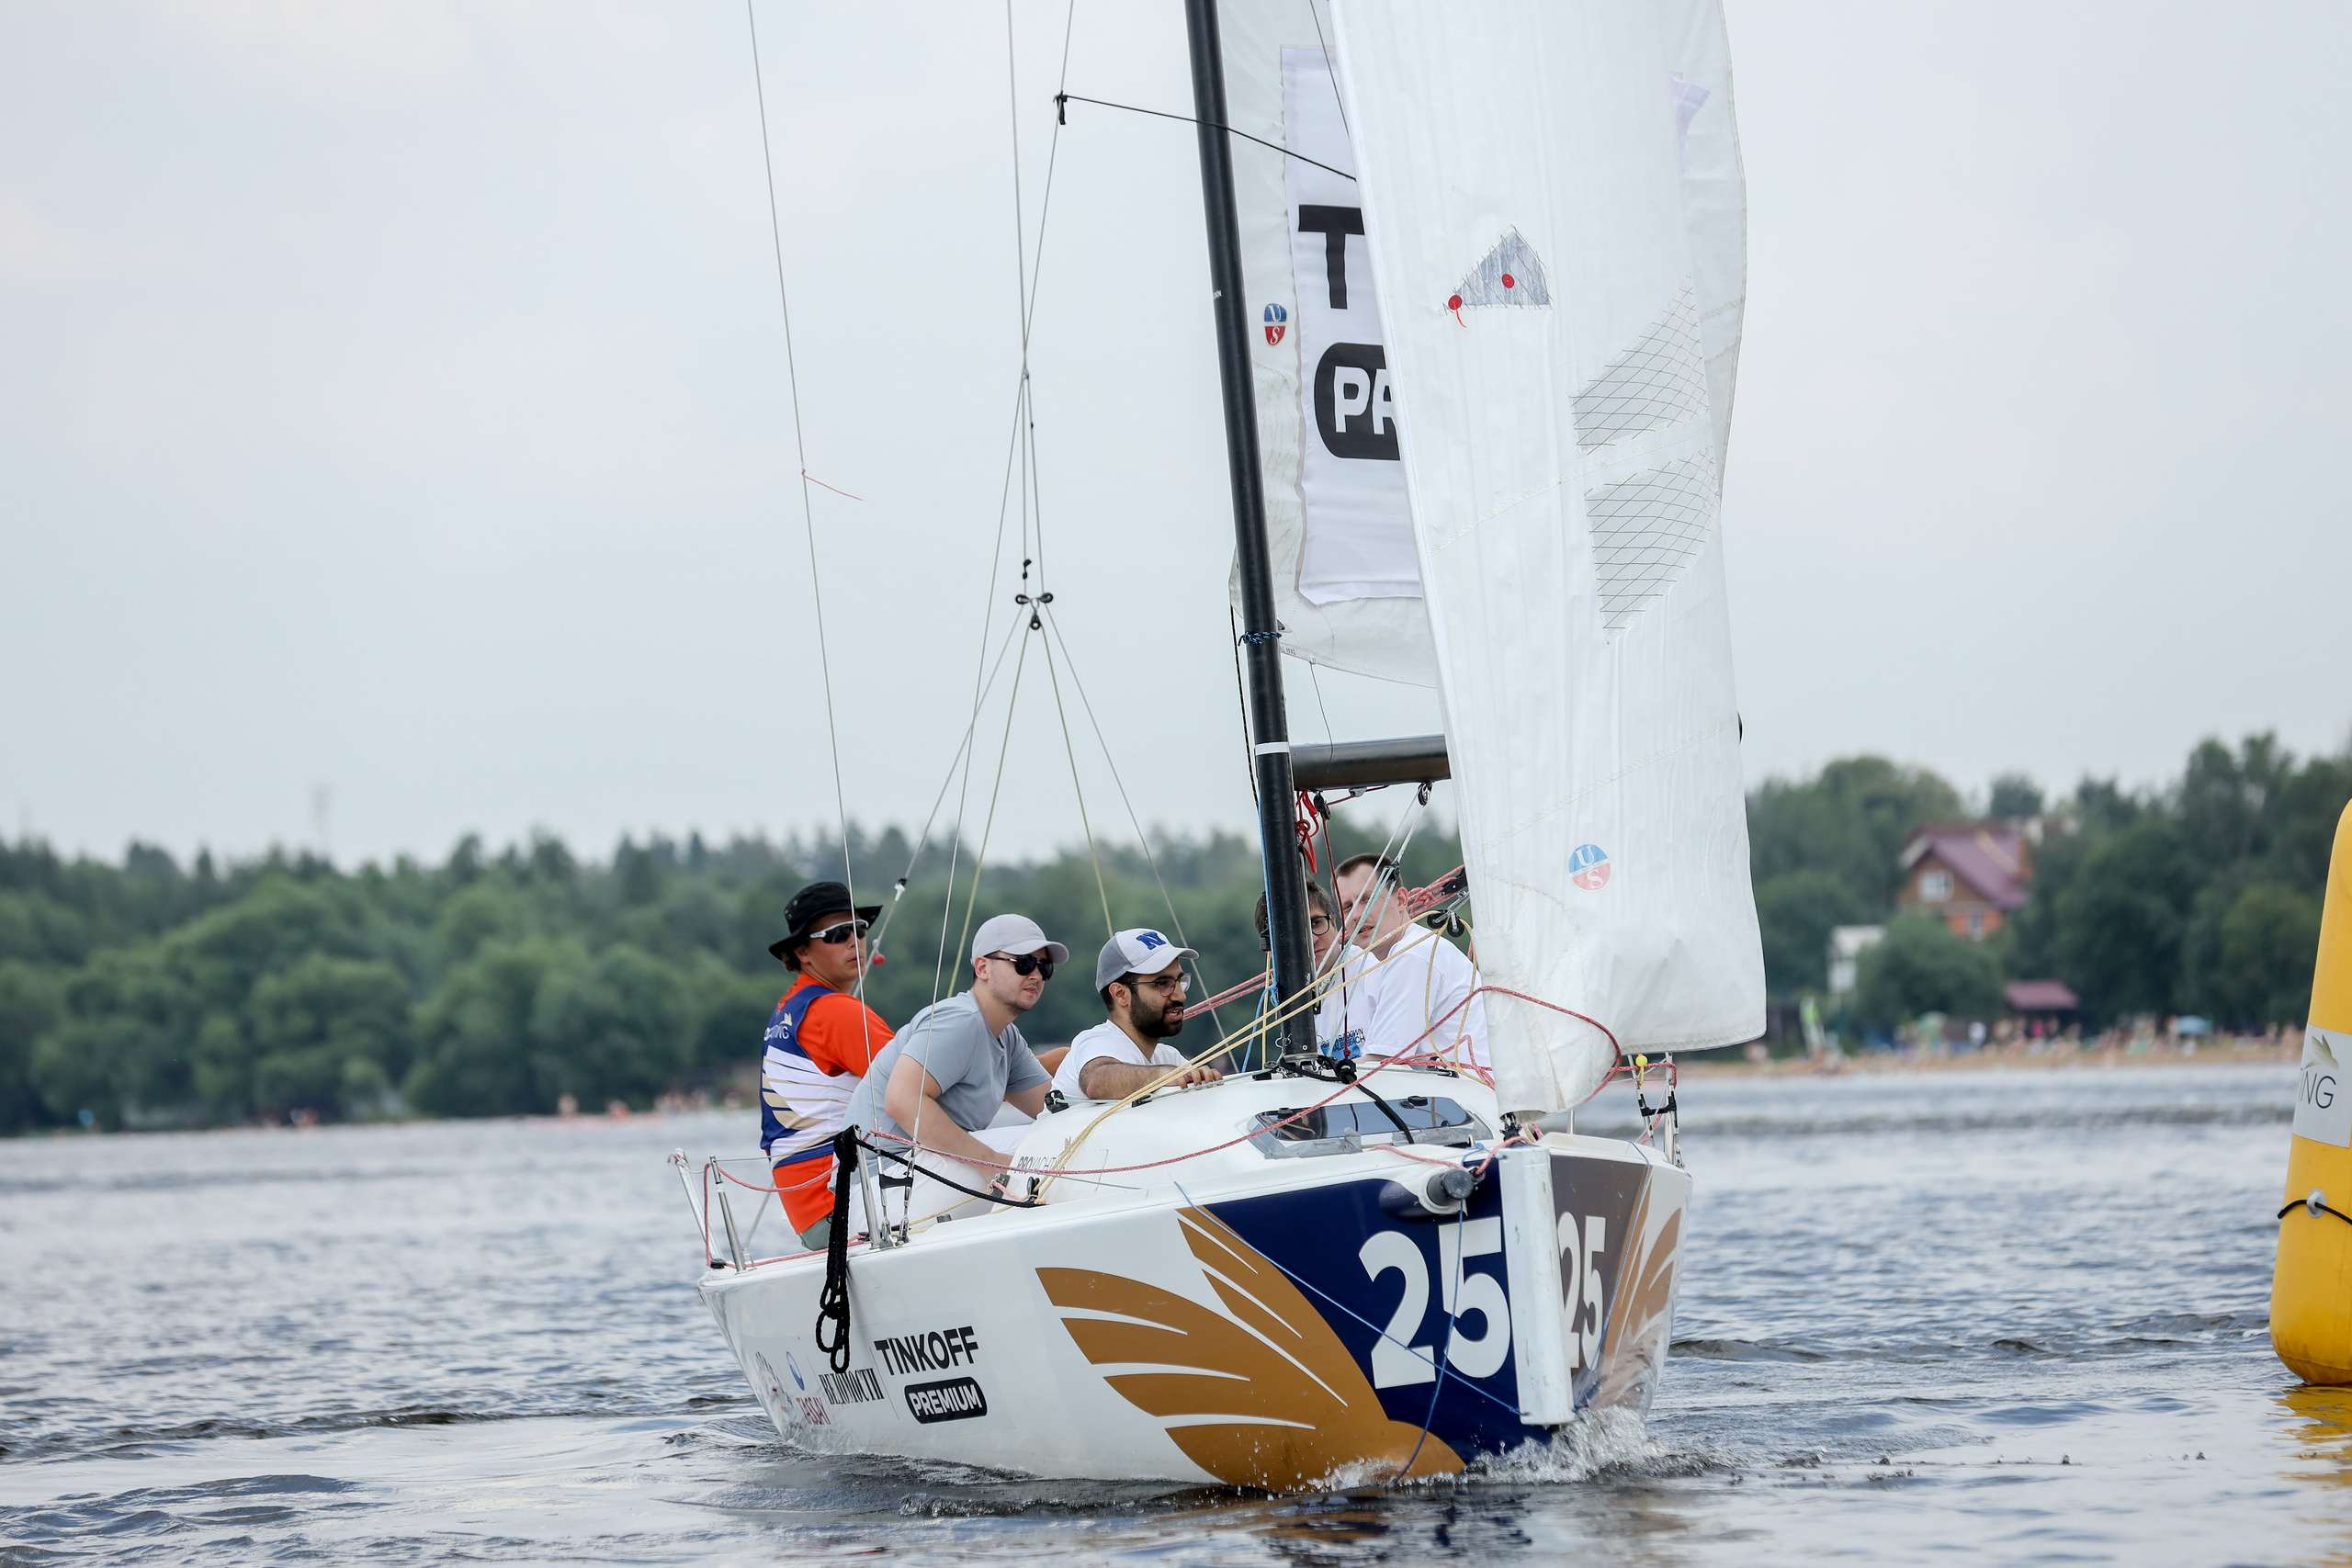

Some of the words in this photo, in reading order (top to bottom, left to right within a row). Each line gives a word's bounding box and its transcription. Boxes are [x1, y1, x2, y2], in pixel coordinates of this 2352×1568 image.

[1574, 845, 1595, 866] U
[1587, 869, 1604, 890] S
[1359, 1216, 1510, 1389] 25
[1557, 1212, 1606, 1371] 25
[874, 1325, 978, 1376] TINKOFF
[908, 1384, 983, 1416] PREMIUM
